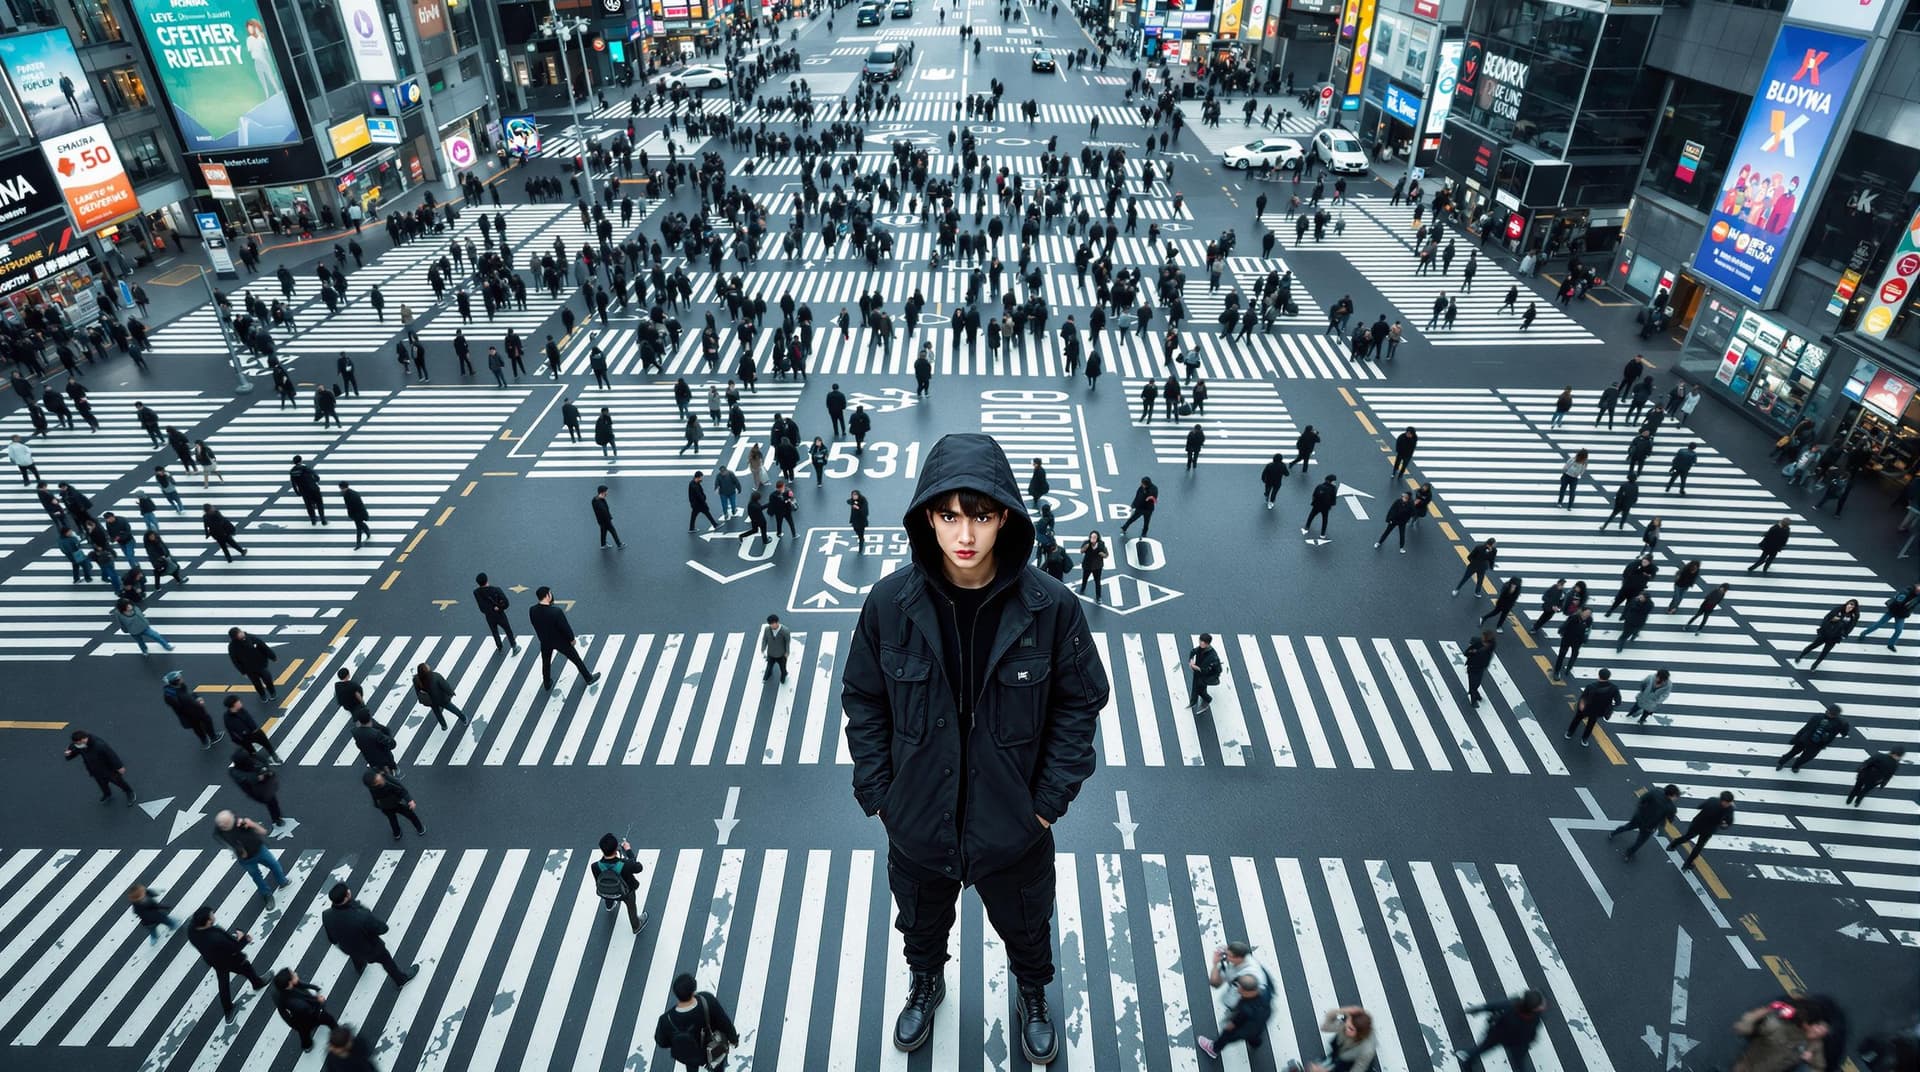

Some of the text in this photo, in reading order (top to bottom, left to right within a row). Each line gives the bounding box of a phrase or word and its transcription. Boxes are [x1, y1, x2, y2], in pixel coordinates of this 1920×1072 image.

[156, 23, 239, 46] CFETHER
[163, 45, 243, 69] RUELLTY
[1765, 80, 1832, 115] BLDYWA
